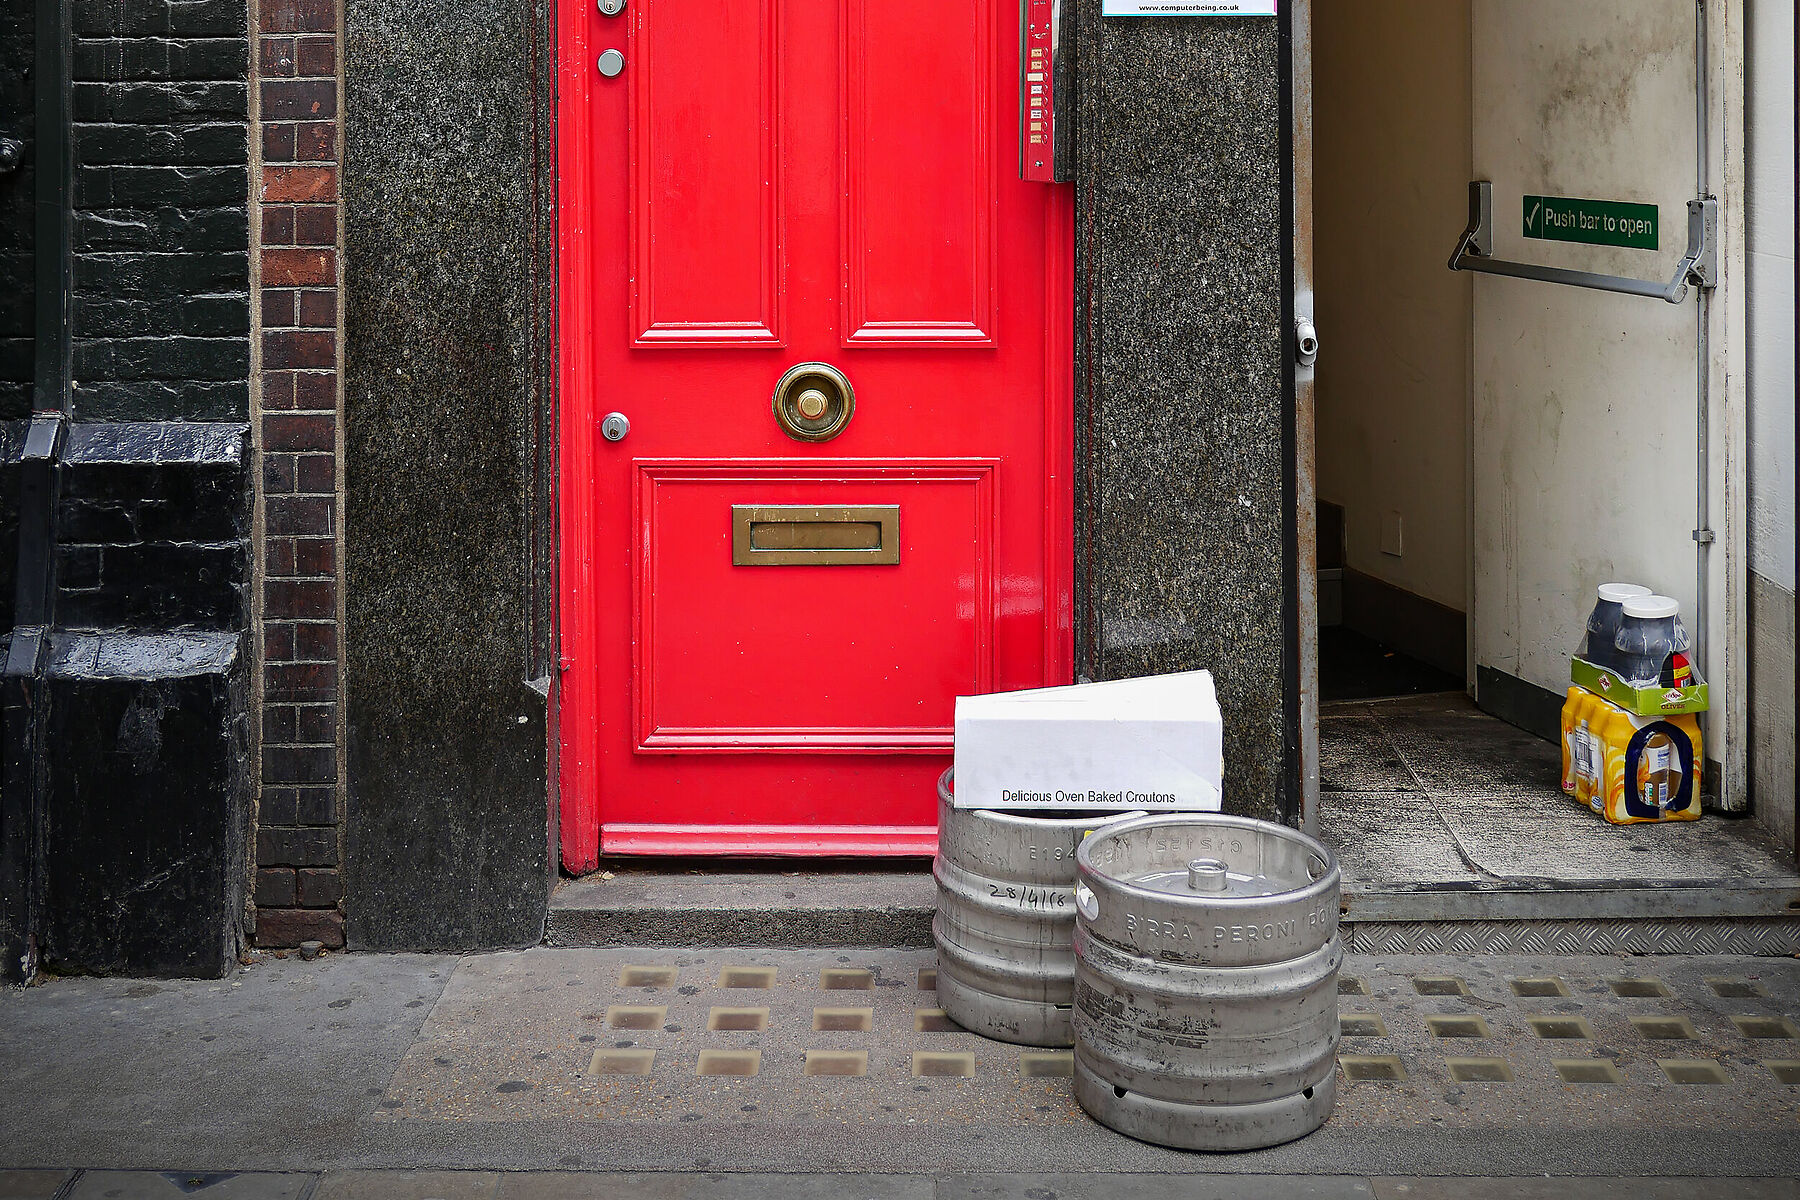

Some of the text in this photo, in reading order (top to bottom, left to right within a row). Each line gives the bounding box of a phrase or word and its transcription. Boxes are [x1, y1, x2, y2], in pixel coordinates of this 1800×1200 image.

[1139, 4, 1239, 12] www.computerbeing.co.uk
[1545, 207, 1652, 238] Push bar to open
[1002, 790, 1176, 803] Delicious Oven Baked Croutons
[1213, 918, 1296, 944] PERONI
